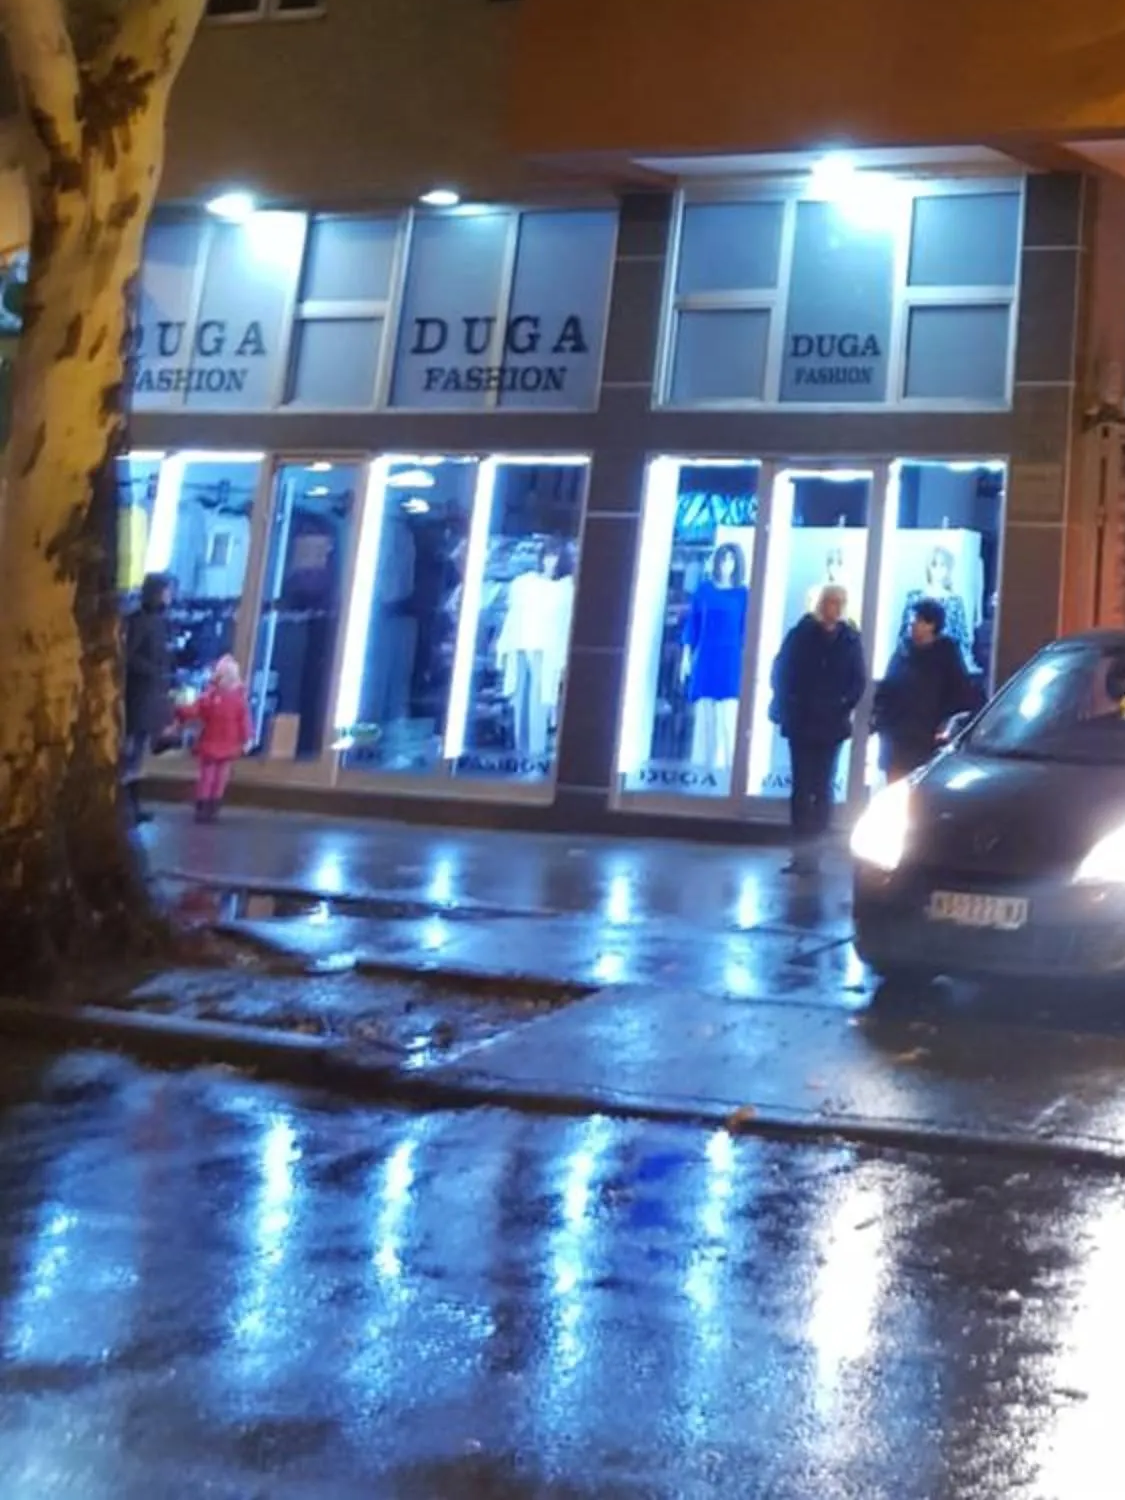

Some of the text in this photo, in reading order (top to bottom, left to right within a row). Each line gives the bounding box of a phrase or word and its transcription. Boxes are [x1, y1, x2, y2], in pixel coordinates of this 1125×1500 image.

[411, 315, 591, 355] DUGA
[790, 333, 881, 358] DUGA
[422, 366, 567, 392] FASHION
[795, 366, 874, 386] FASHION
